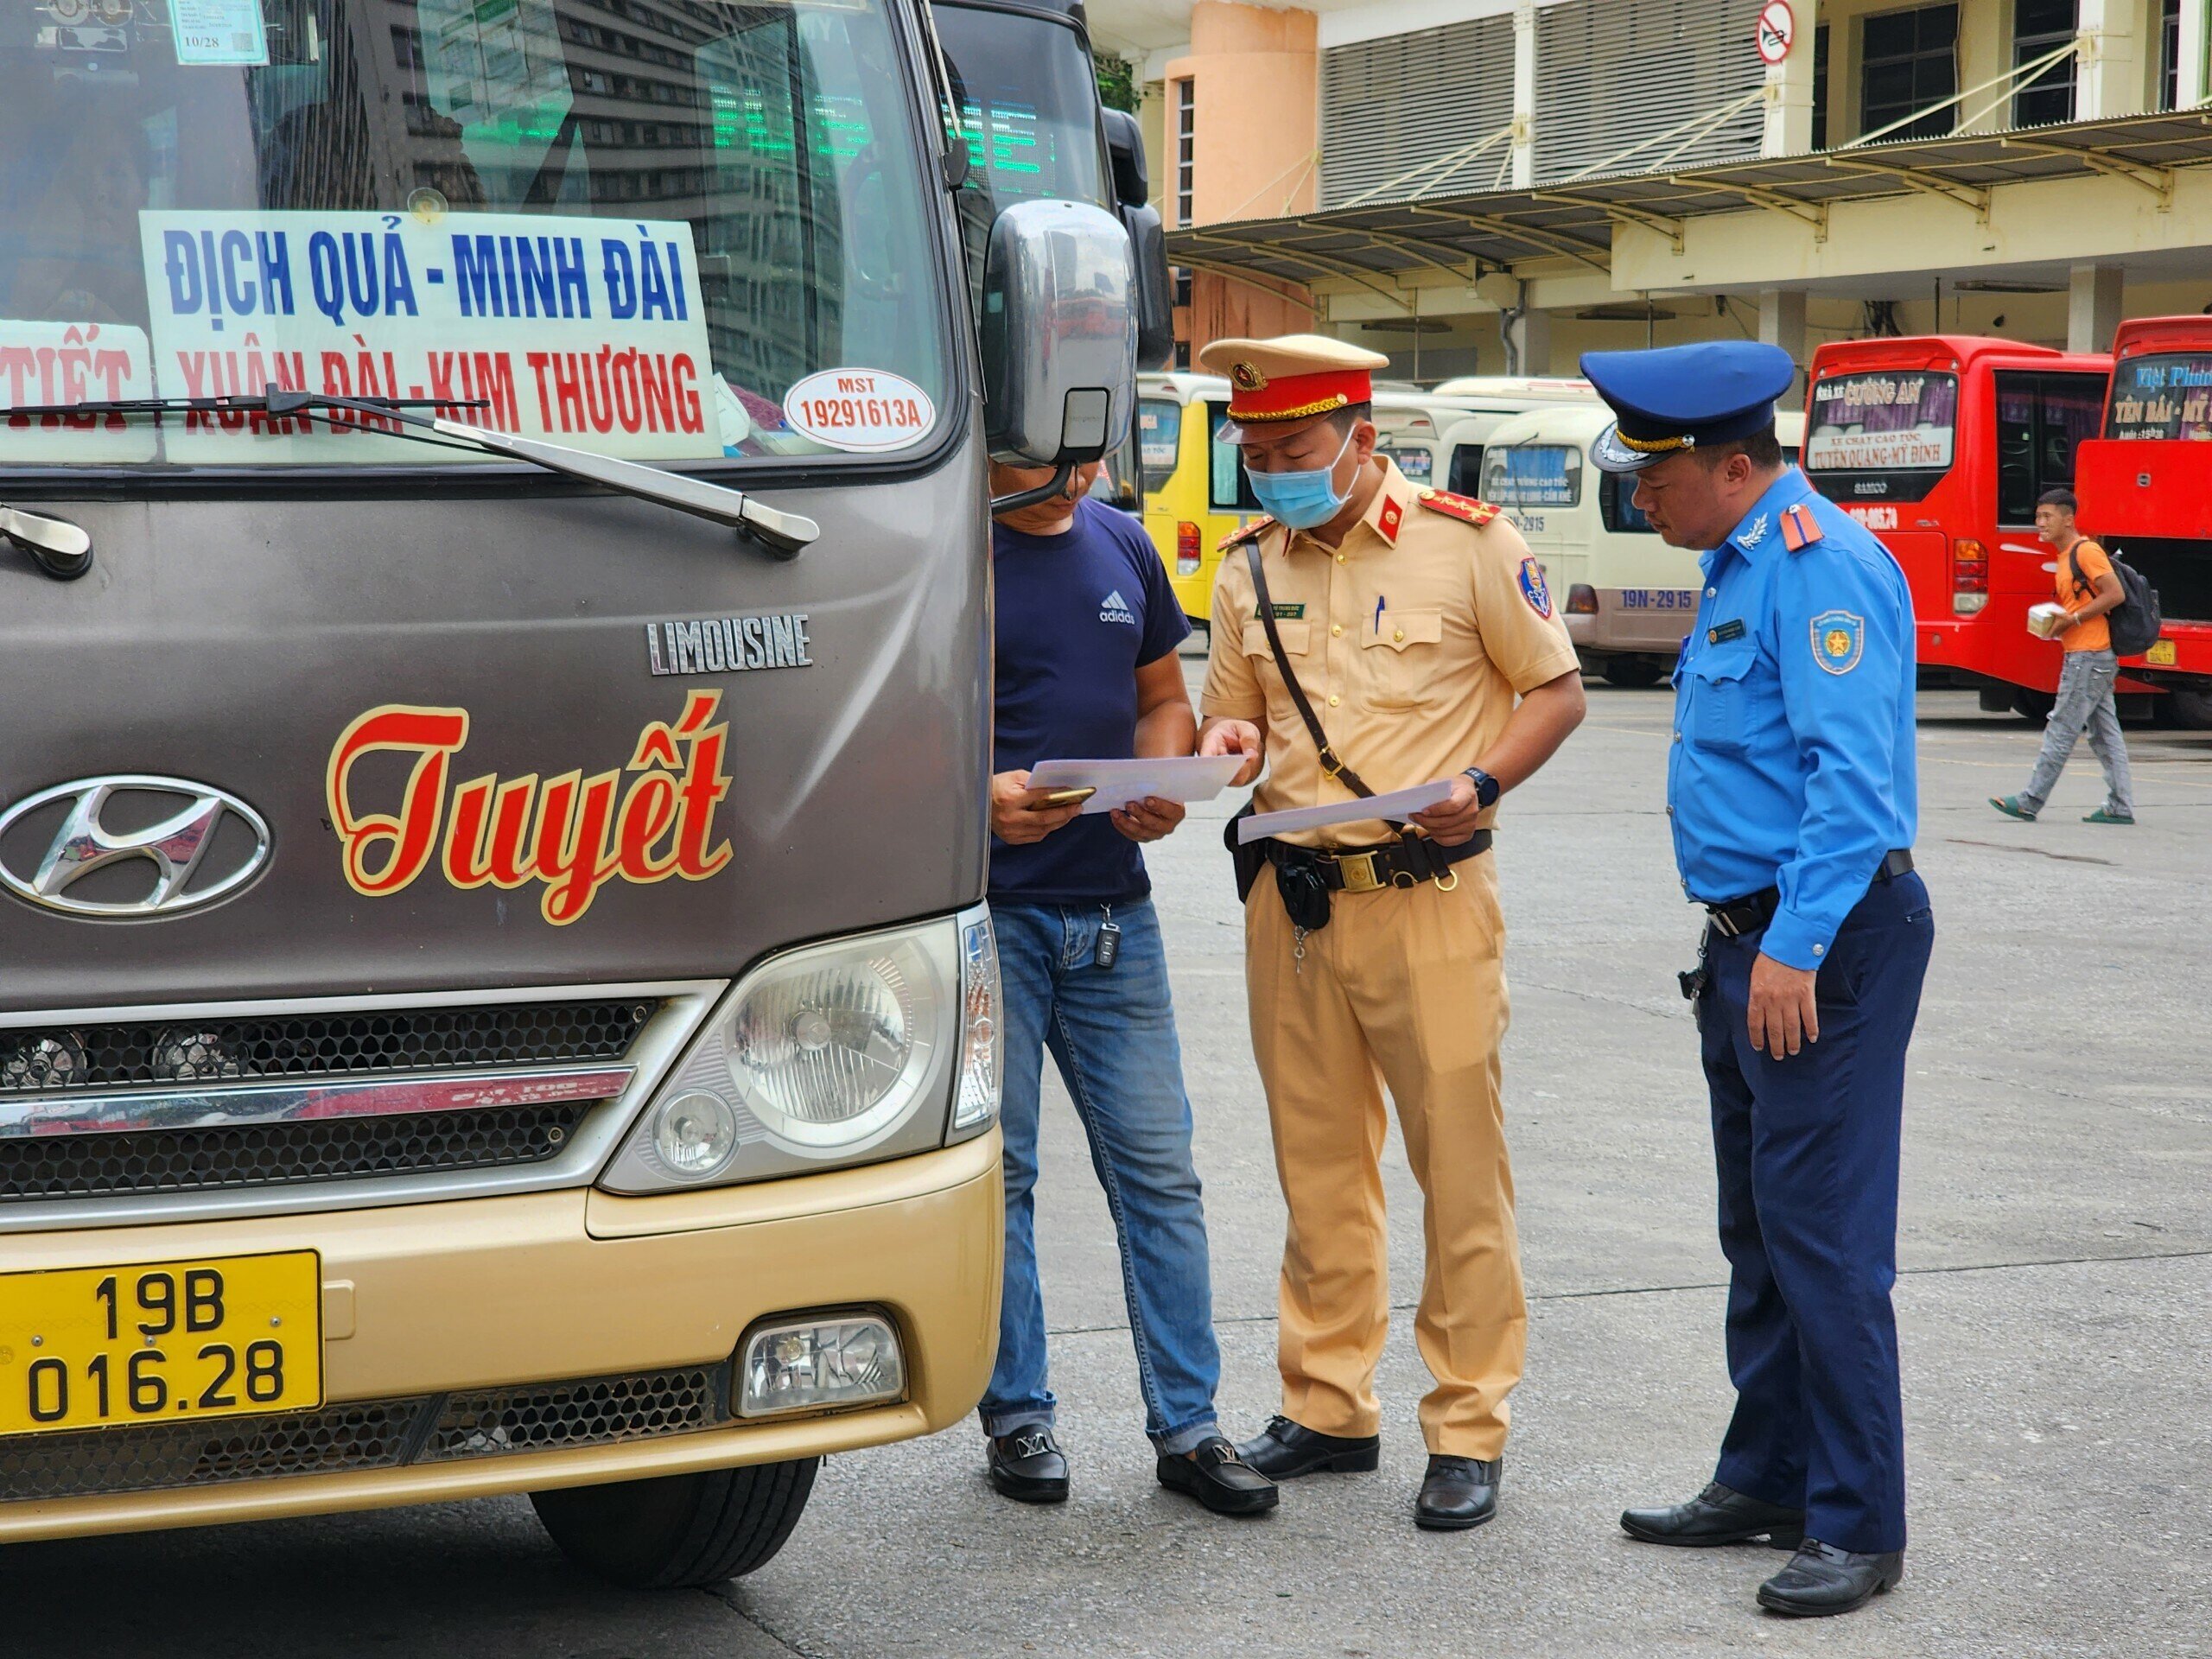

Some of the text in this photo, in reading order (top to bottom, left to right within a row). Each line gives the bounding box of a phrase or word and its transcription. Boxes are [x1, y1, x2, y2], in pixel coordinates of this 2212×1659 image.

[185, 36, 219, 48] 10/28
[163, 229, 296, 332] ĐỊCH
[308, 215, 419, 327] QUẢ
[451, 234, 592, 320] MINH
[601, 224, 689, 321] ĐÀI
[176, 332, 313, 435] XUÂN
[526, 344, 705, 435] THƯƠNG
[837, 378, 875, 393] MST
[801, 399, 923, 429] 19291613A
[1875, 435, 1896, 443] CAO
[1099, 609, 1135, 625] adidas
[1621, 590, 1692, 608] 19N-2915
[647, 614, 814, 676] LIMOUSINE
[326, 689, 734, 926] Tuyết
[96, 1268, 226, 1340] 19B
[28, 1339, 284, 1423] 016.28
